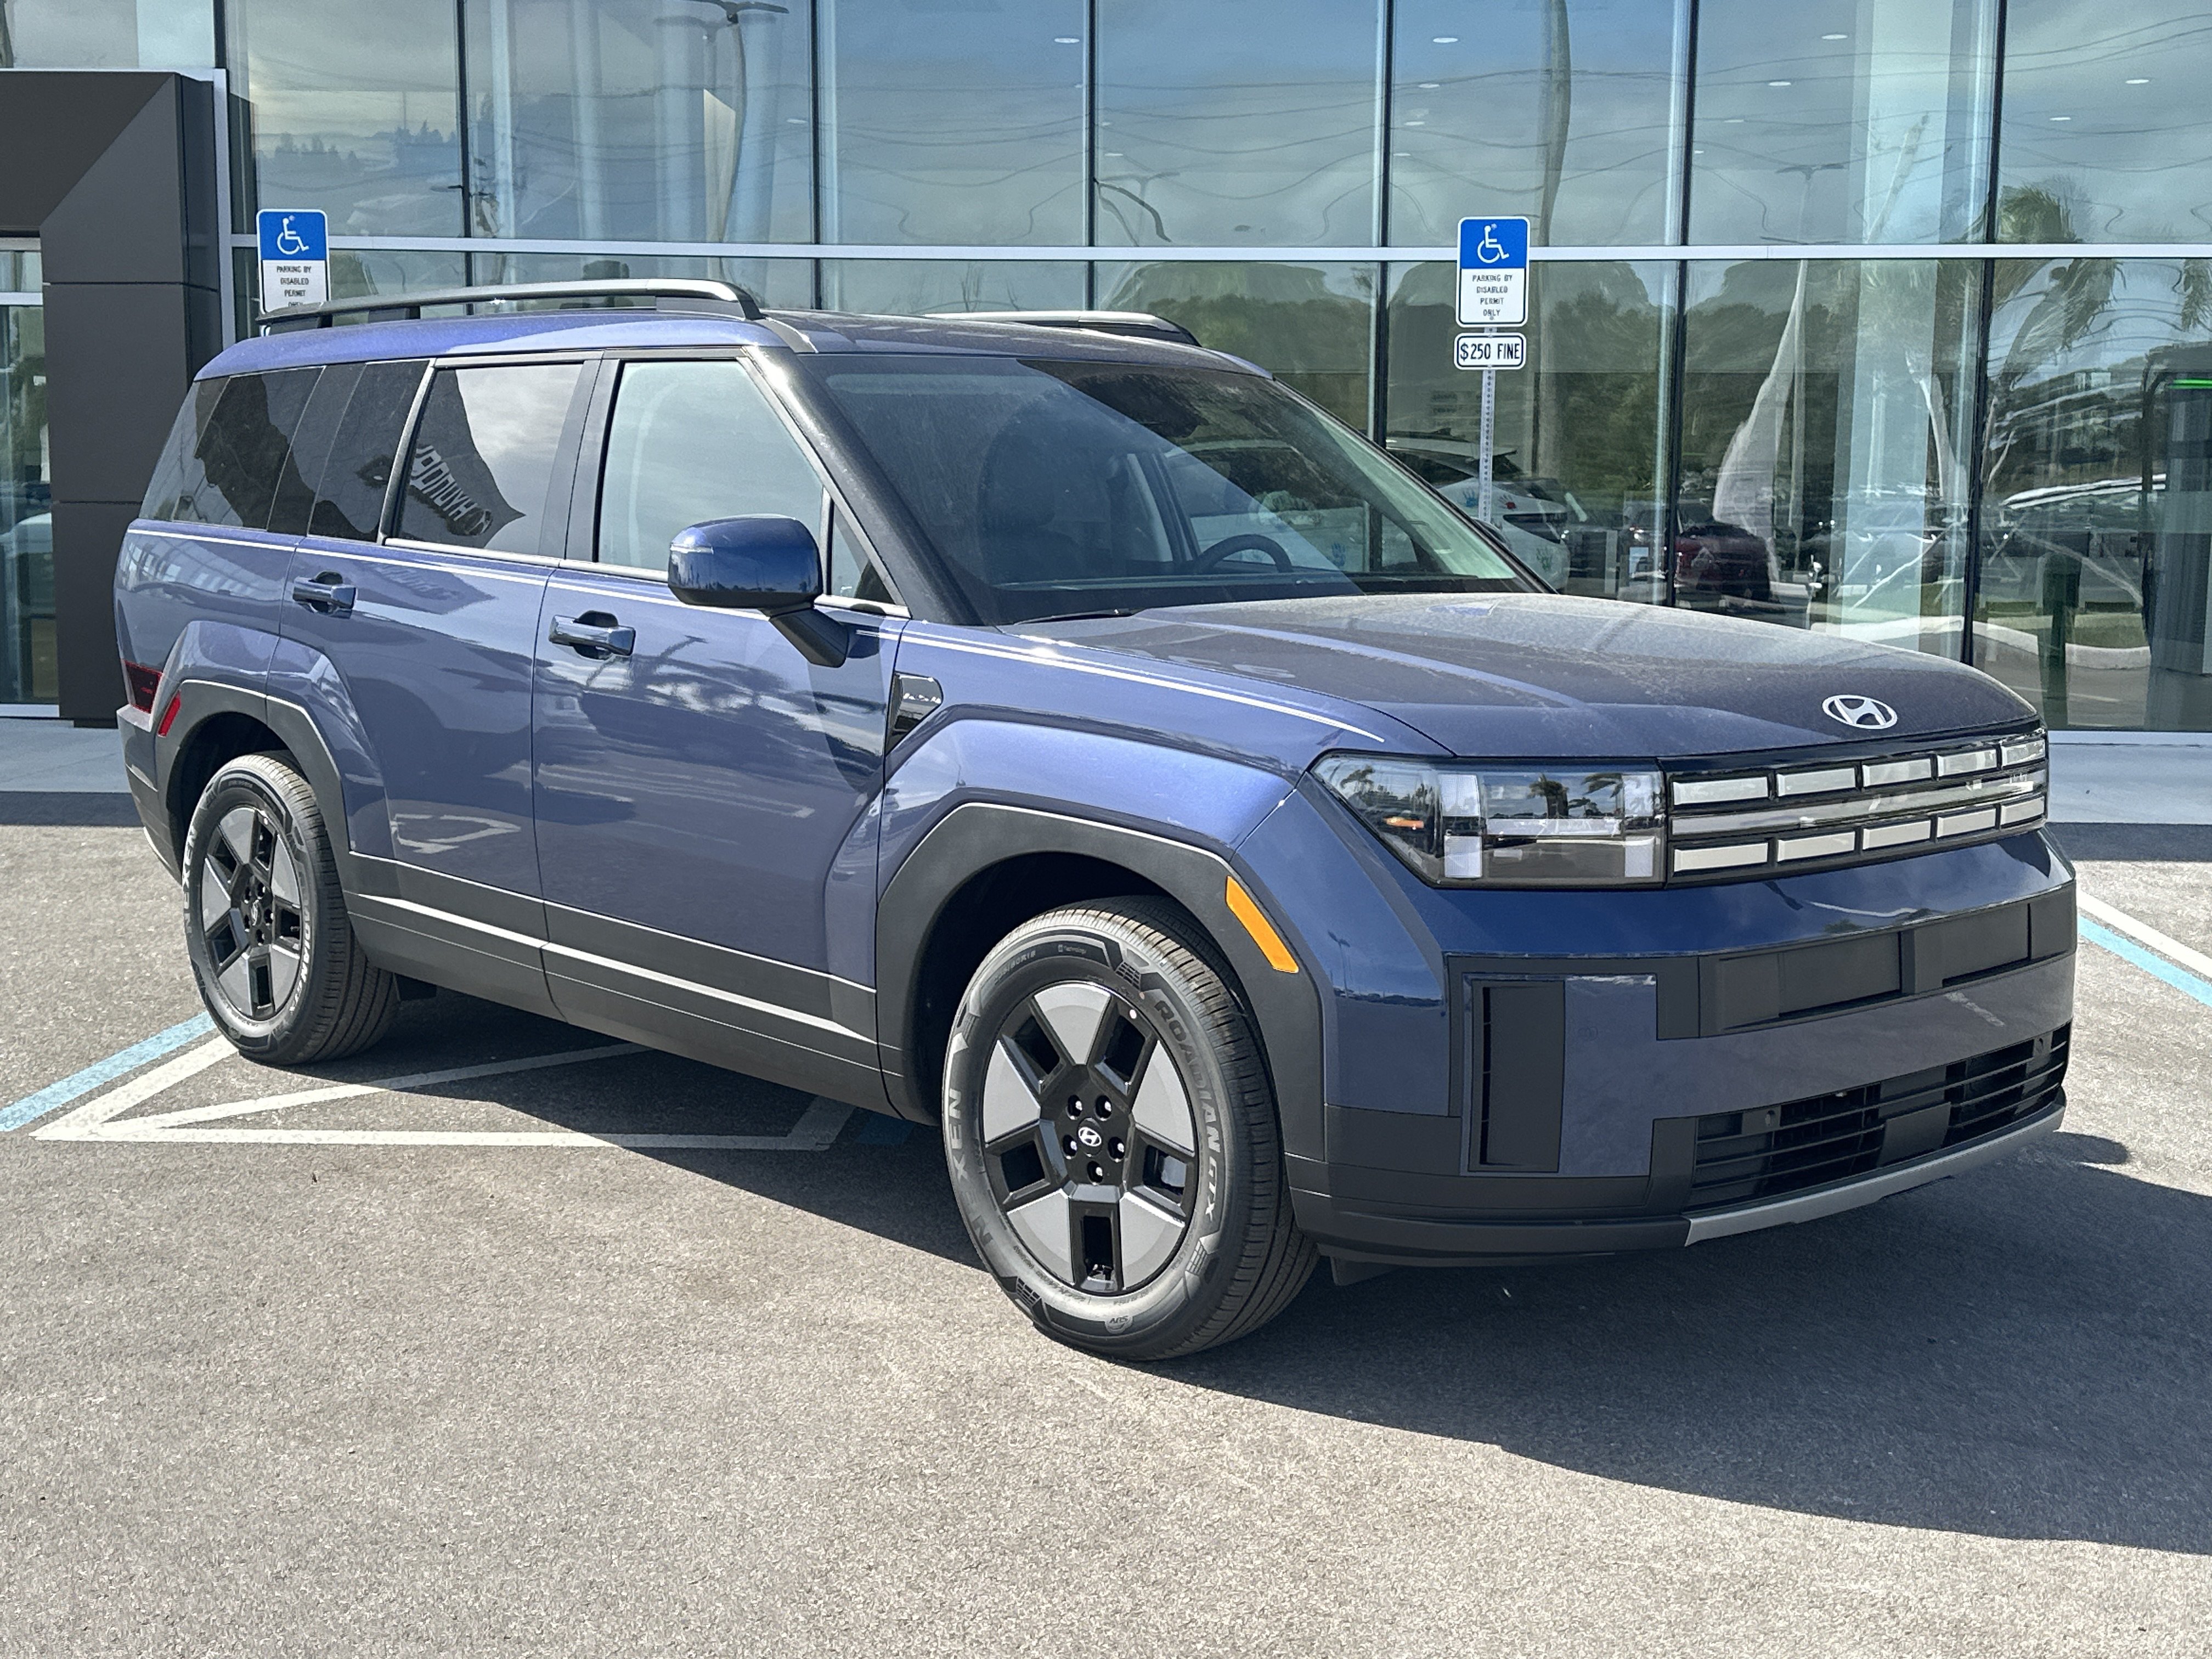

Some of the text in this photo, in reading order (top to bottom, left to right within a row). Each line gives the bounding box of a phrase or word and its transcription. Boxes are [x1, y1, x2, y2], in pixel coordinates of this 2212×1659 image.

[1460, 342, 1520, 362] $250 FINE
[949, 1088, 994, 1246] NEXEN
[1154, 1000, 1221, 1222] ROADIAN GTX
